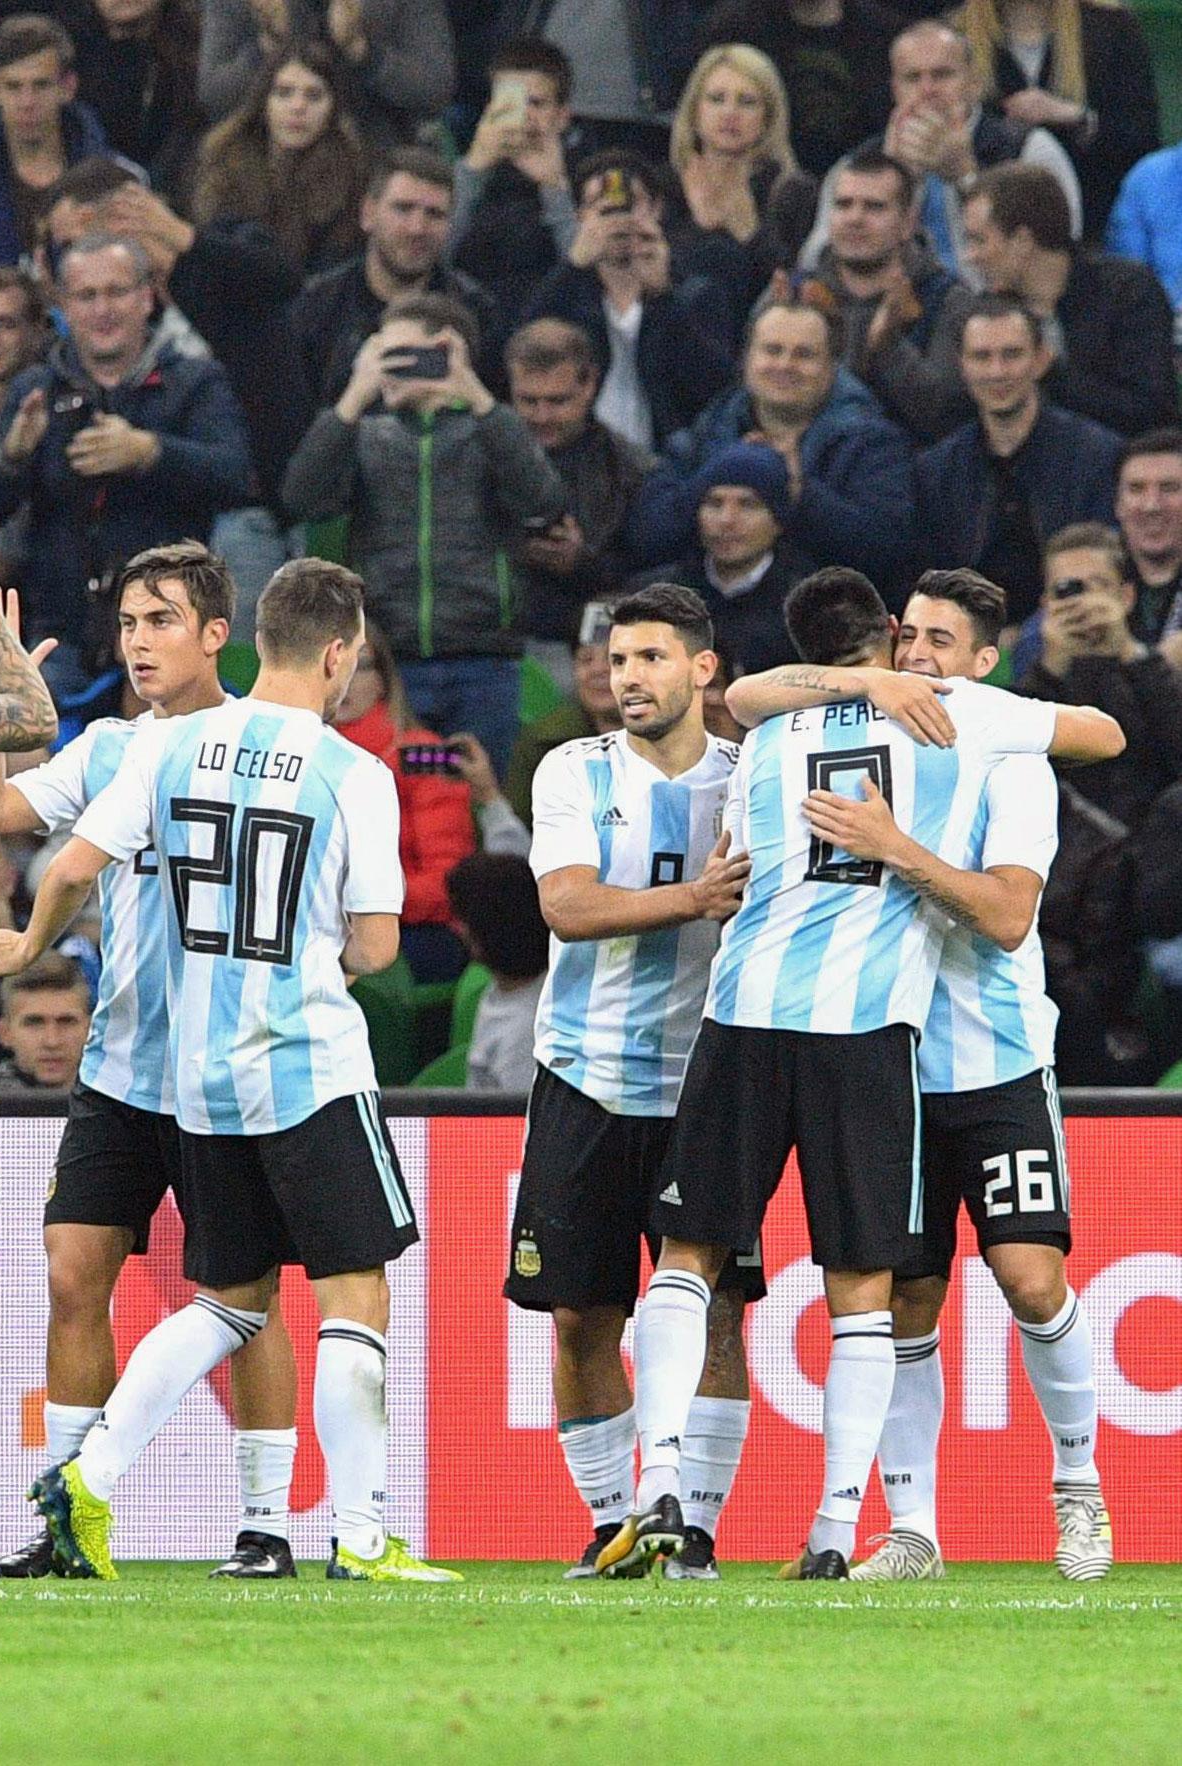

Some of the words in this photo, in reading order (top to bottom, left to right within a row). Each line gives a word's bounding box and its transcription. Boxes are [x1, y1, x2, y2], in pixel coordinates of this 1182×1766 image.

[822, 702, 887, 729] PERE
[197, 742, 227, 771] LO
[232, 747, 303, 783] CELSO
[169, 797, 315, 966] 20
[982, 1149, 1056, 1219] 26
